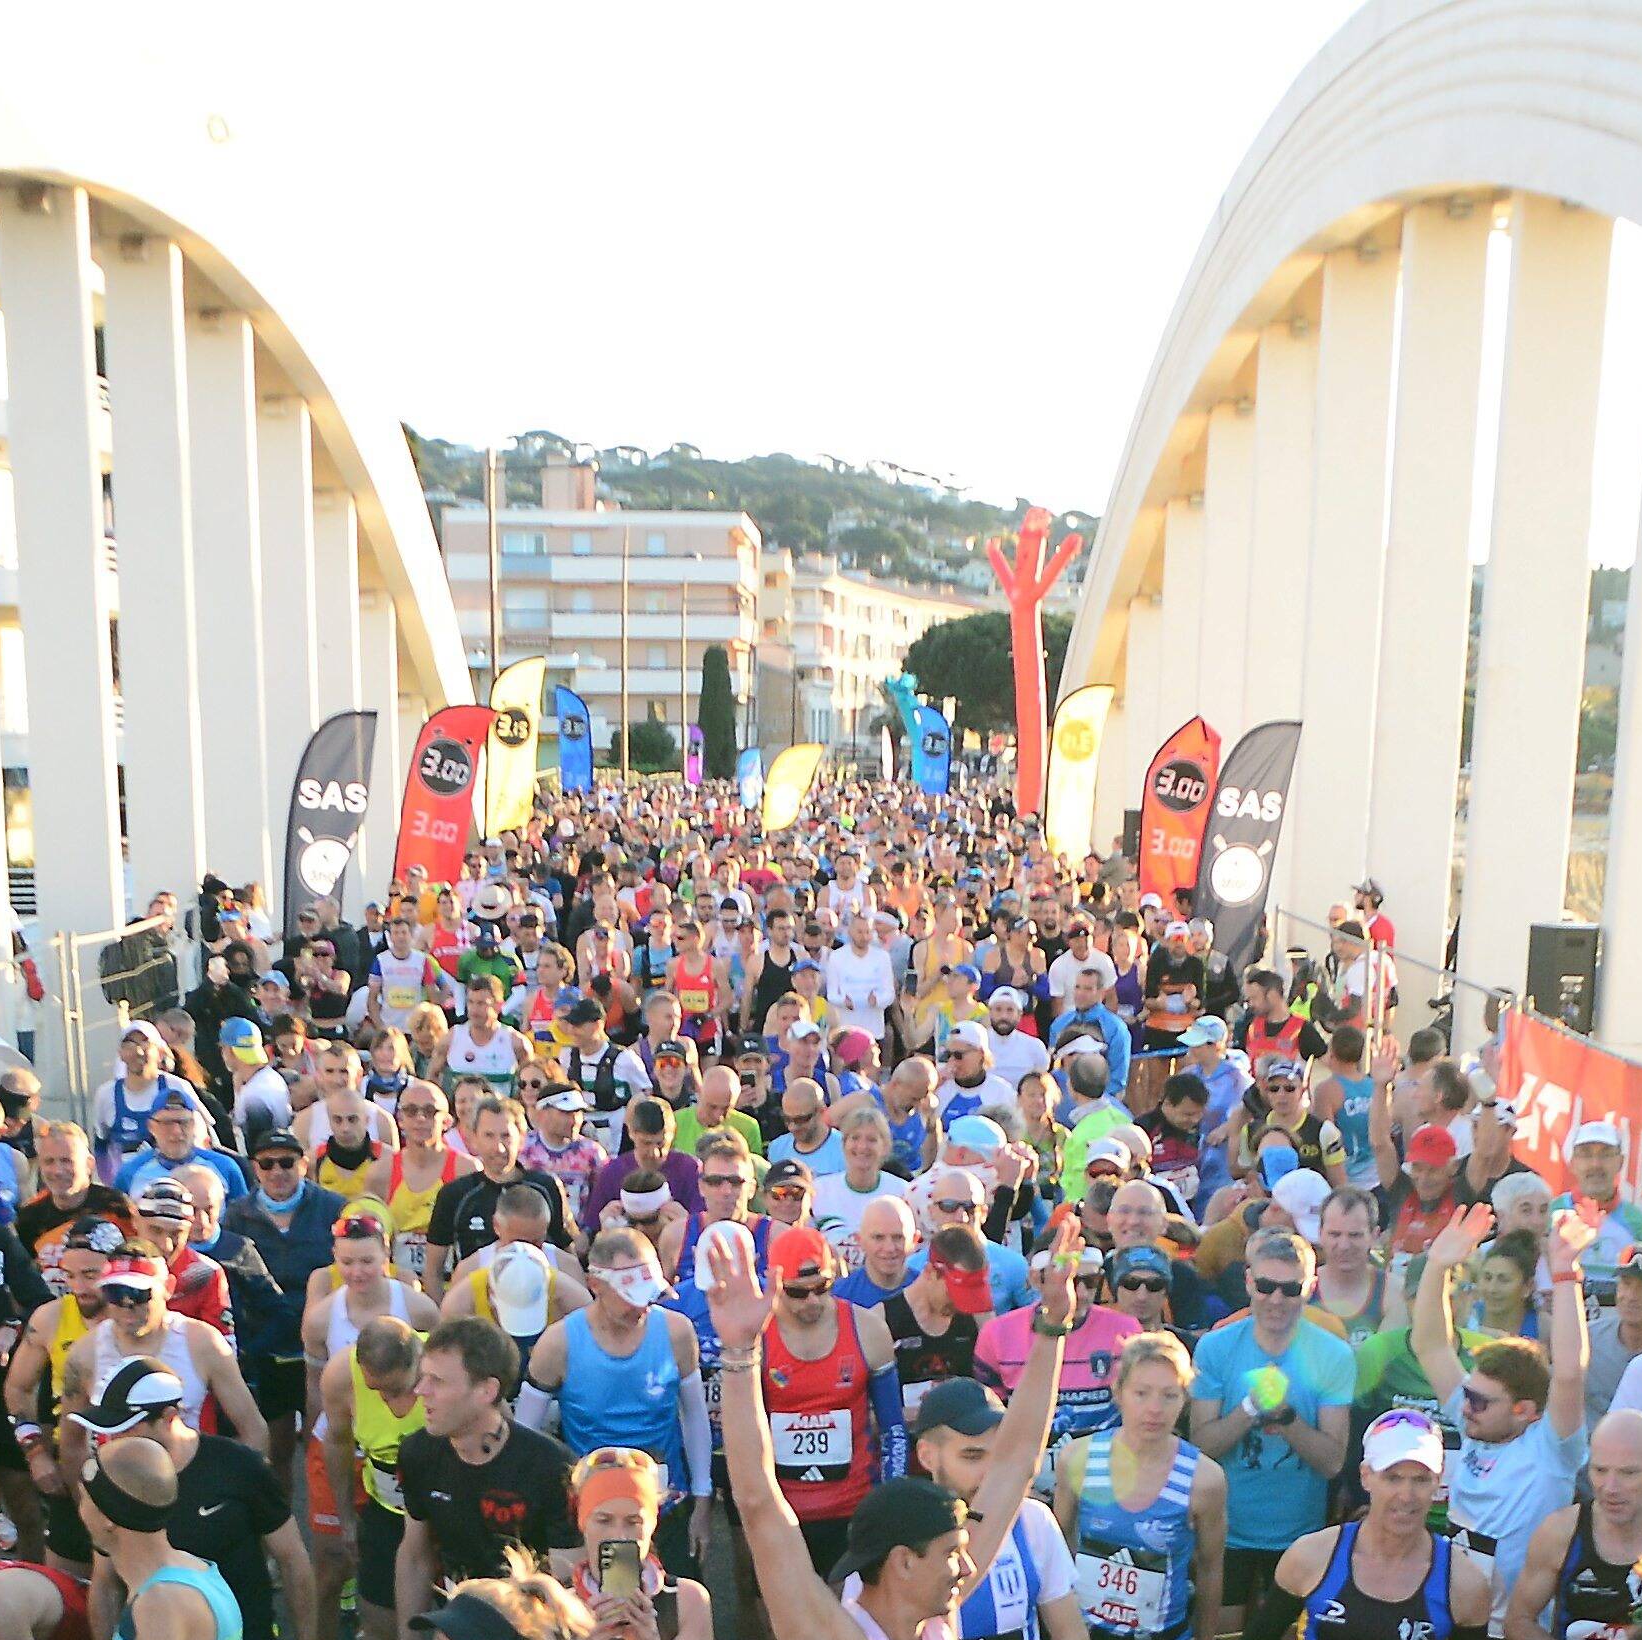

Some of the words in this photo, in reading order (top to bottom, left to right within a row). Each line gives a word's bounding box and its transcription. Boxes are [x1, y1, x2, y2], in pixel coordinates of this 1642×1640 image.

[421, 746, 470, 785] 3.00
[298, 779, 368, 814] SAS
[1156, 767, 1207, 803] 3.00
[1216, 786, 1283, 822] SAS
[411, 811, 458, 842] 3.00
[1150, 828, 1196, 859] 3.00
[792, 1429, 830, 1456] 239
[1097, 1562, 1139, 1596] 346
